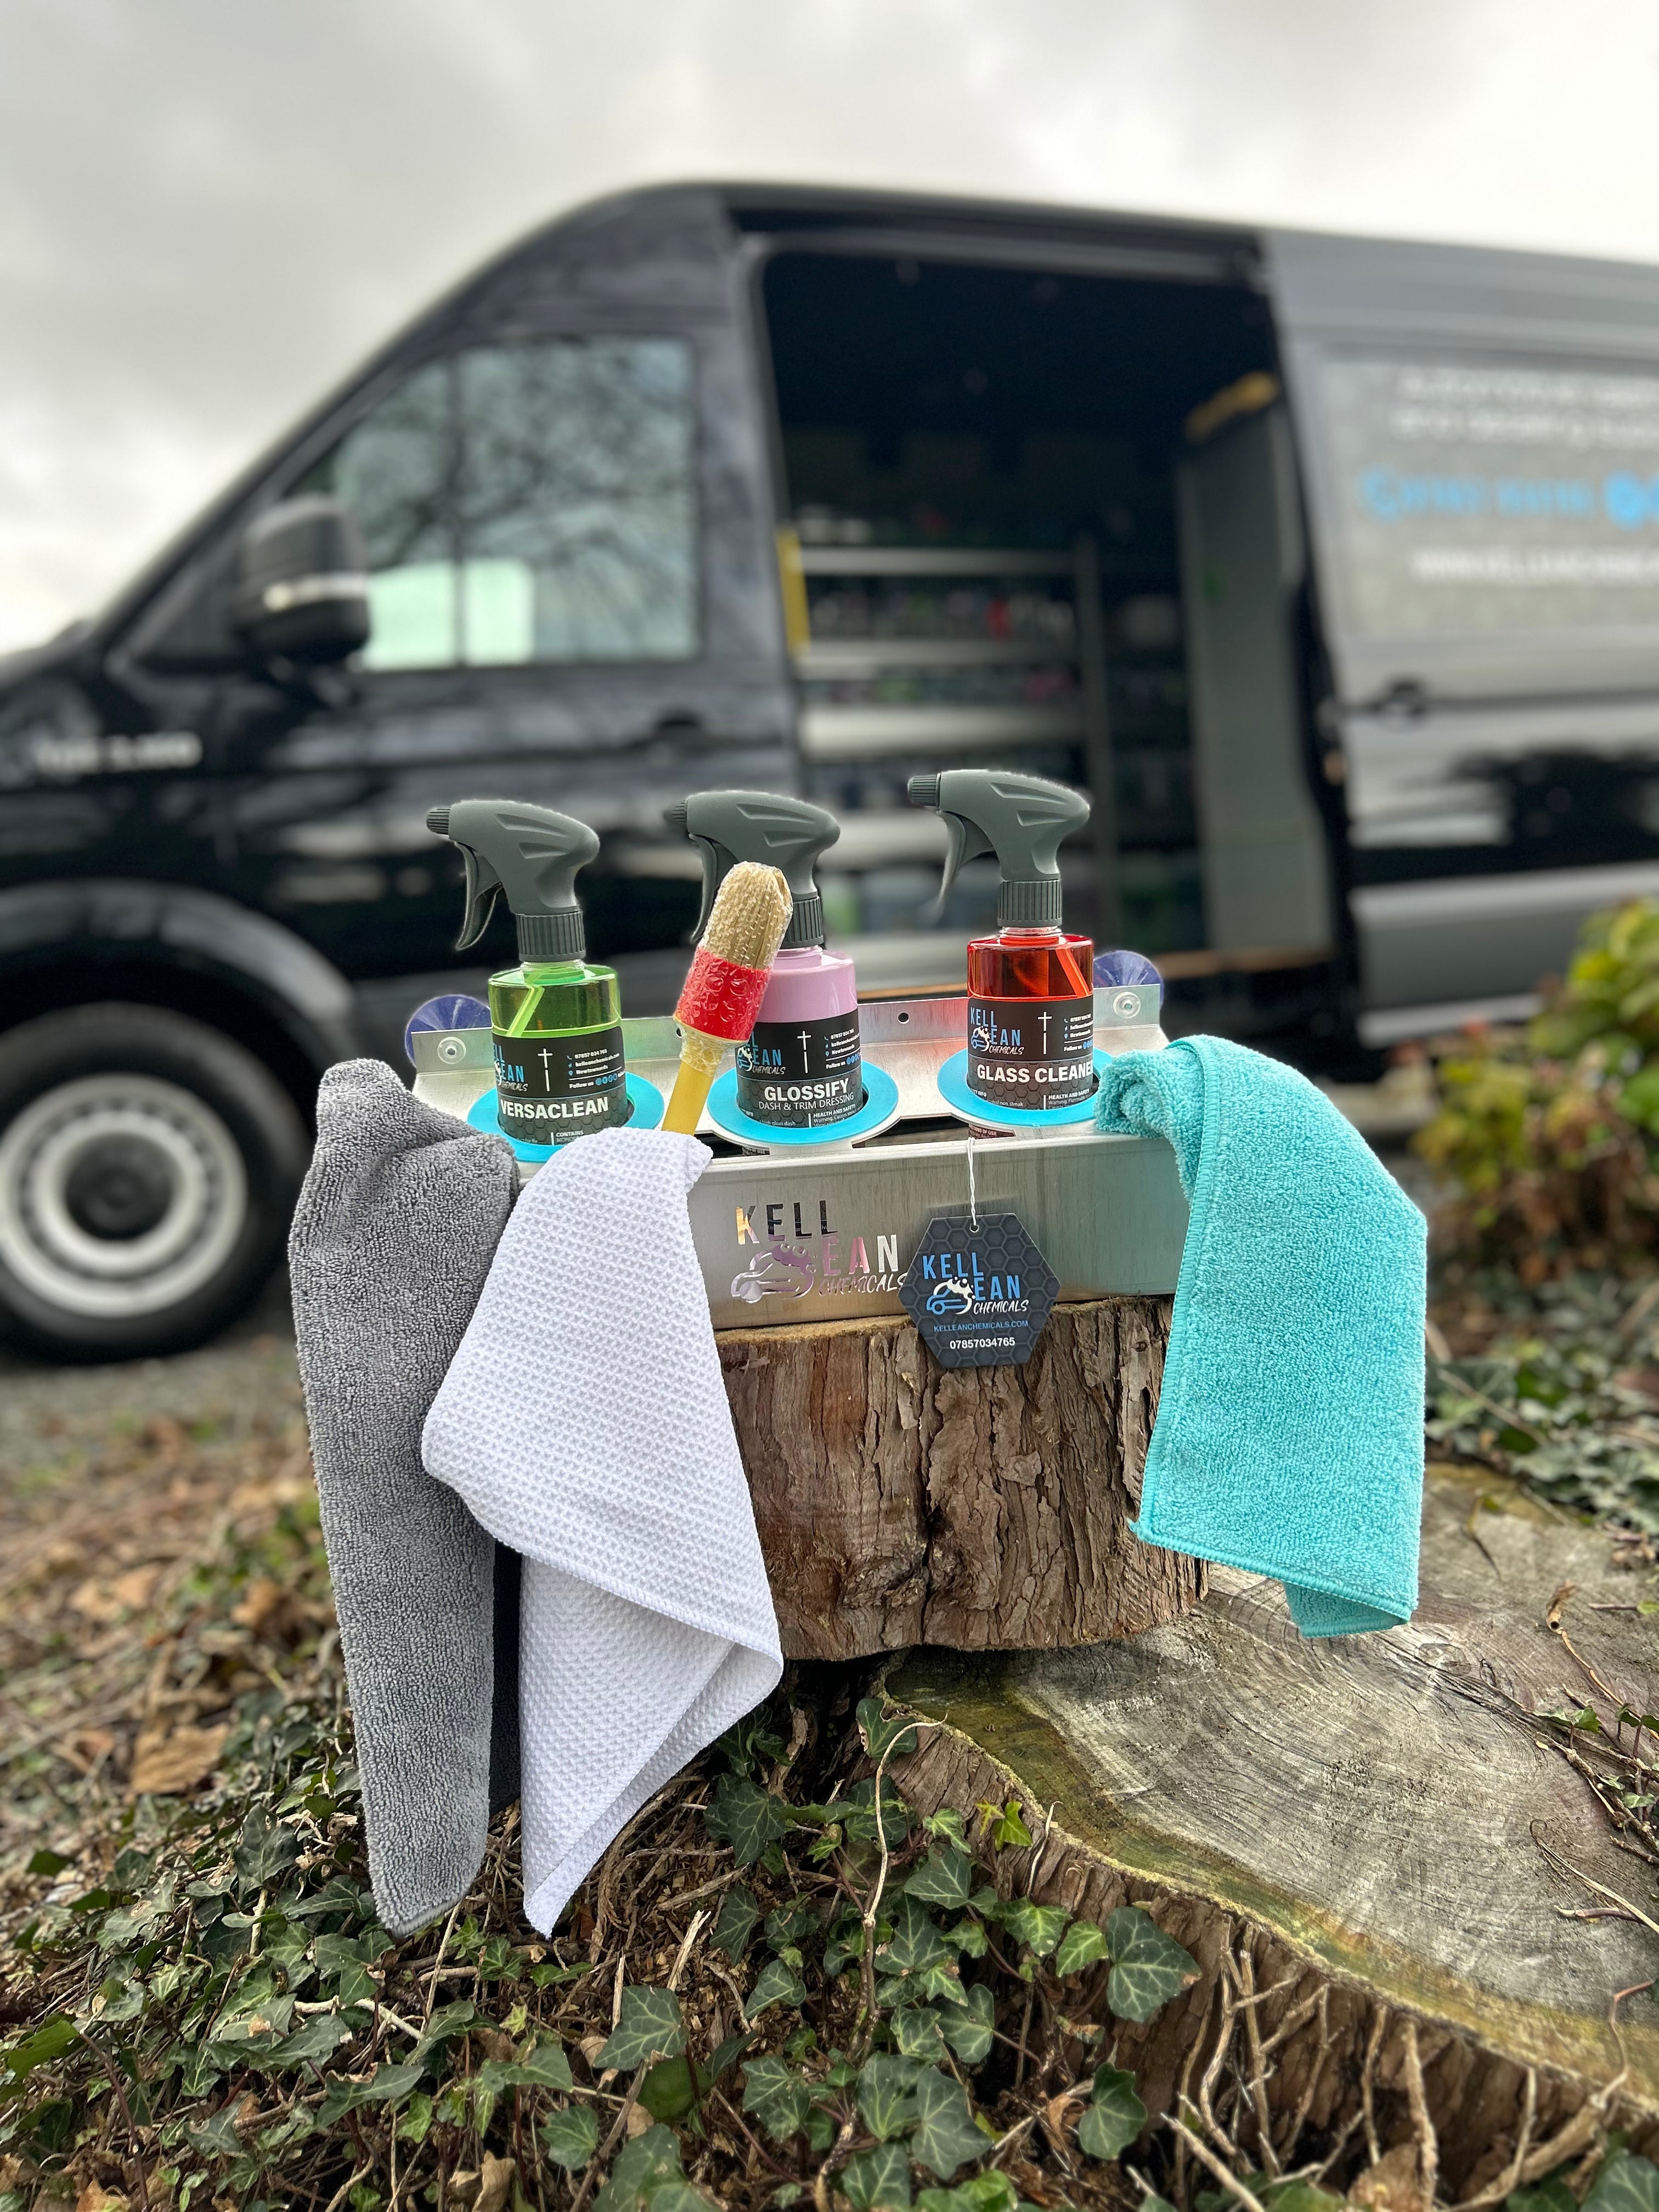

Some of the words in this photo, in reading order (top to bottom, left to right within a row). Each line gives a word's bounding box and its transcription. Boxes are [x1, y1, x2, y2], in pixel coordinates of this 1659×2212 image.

[970, 1007, 997, 1028] KELL
[990, 1029, 1021, 1046] EAN
[753, 1048, 782, 1066] EAN
[989, 1046, 1024, 1056] CHEMICALS
[500, 1063, 524, 1083] EAN
[752, 1065, 786, 1075] CHEMICALS
[977, 1064, 1030, 1083] GLASS
[764, 1077, 850, 1102] GLOSSIFY
[1078, 1088, 1090, 1096] SAFETY
[500, 1097, 609, 1119] VERSACLEAN
[759, 1101, 781, 1110] DASH
[783, 1102, 792, 1110] &
[793, 1101, 816, 1110] TRIM
[819, 1092, 854, 1108] DRESSING
[736, 1200, 838, 1245] KELL
[823, 1234, 899, 1277] EAN
[923, 1252, 984, 1280] KELL
[973, 1274, 1021, 1301] EAN
[973, 1299, 1030, 1315] CHEMICALS
[934, 1320, 1029, 1333] KELLEANCHEMICALS.COM
[950, 1336, 1016, 1350] 07857034765
